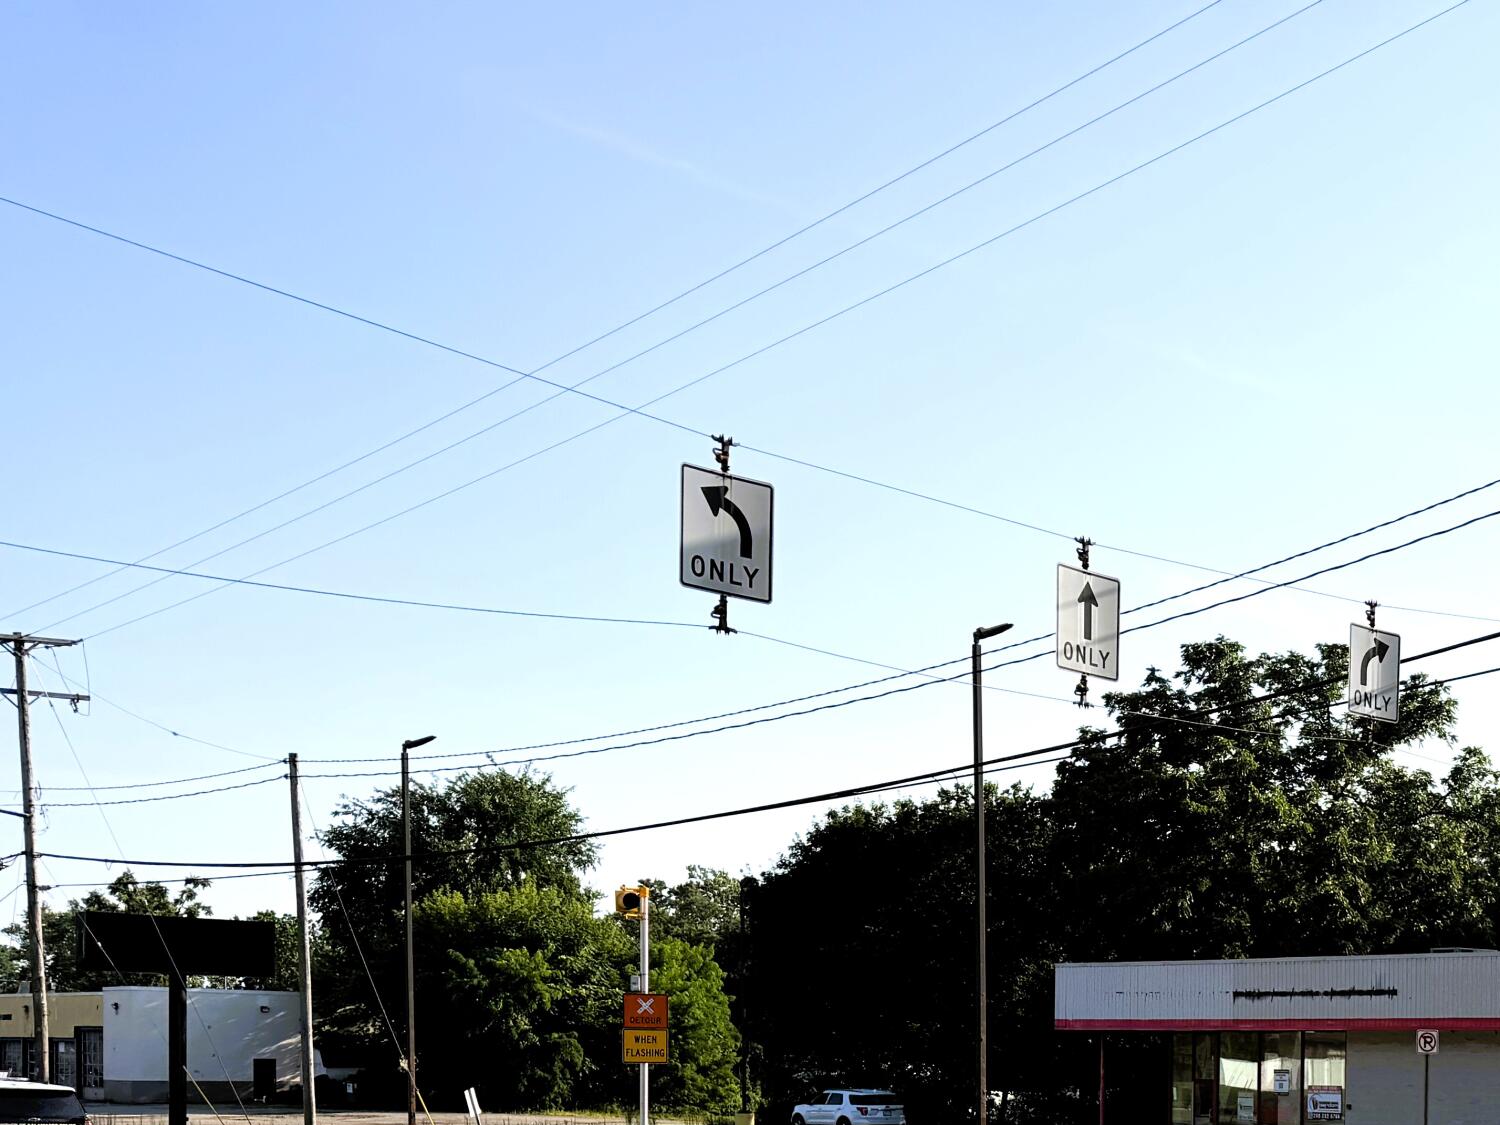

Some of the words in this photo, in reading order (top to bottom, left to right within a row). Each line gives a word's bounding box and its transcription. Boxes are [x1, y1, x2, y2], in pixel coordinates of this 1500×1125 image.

[690, 554, 760, 589] ONLY
[1063, 641, 1110, 669] ONLY
[1354, 689, 1392, 712] ONLY
[629, 1016, 662, 1025] DETOUR
[633, 1035, 657, 1044] WHEN
[625, 1048, 665, 1057] FLASHING
